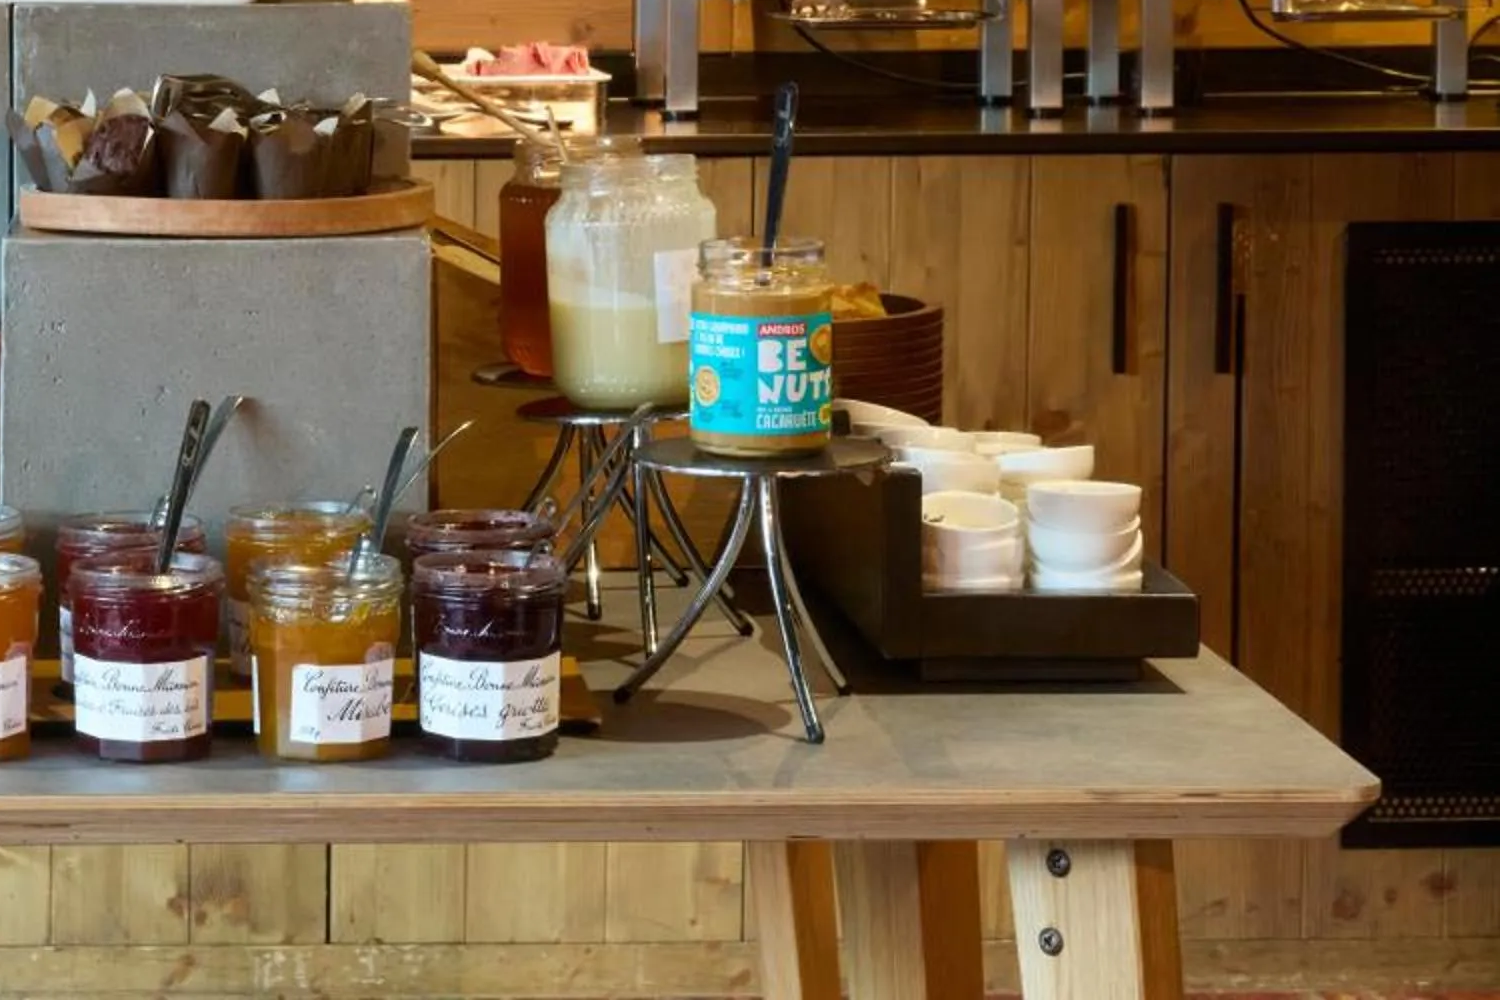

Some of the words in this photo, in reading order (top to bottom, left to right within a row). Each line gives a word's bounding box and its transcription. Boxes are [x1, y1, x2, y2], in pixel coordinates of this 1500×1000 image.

[759, 323, 805, 336] ANDROS
[757, 338, 807, 373] BE
[101, 666, 149, 693] Bonne
[302, 669, 360, 699] Confiture
[467, 666, 514, 690] Bonne
